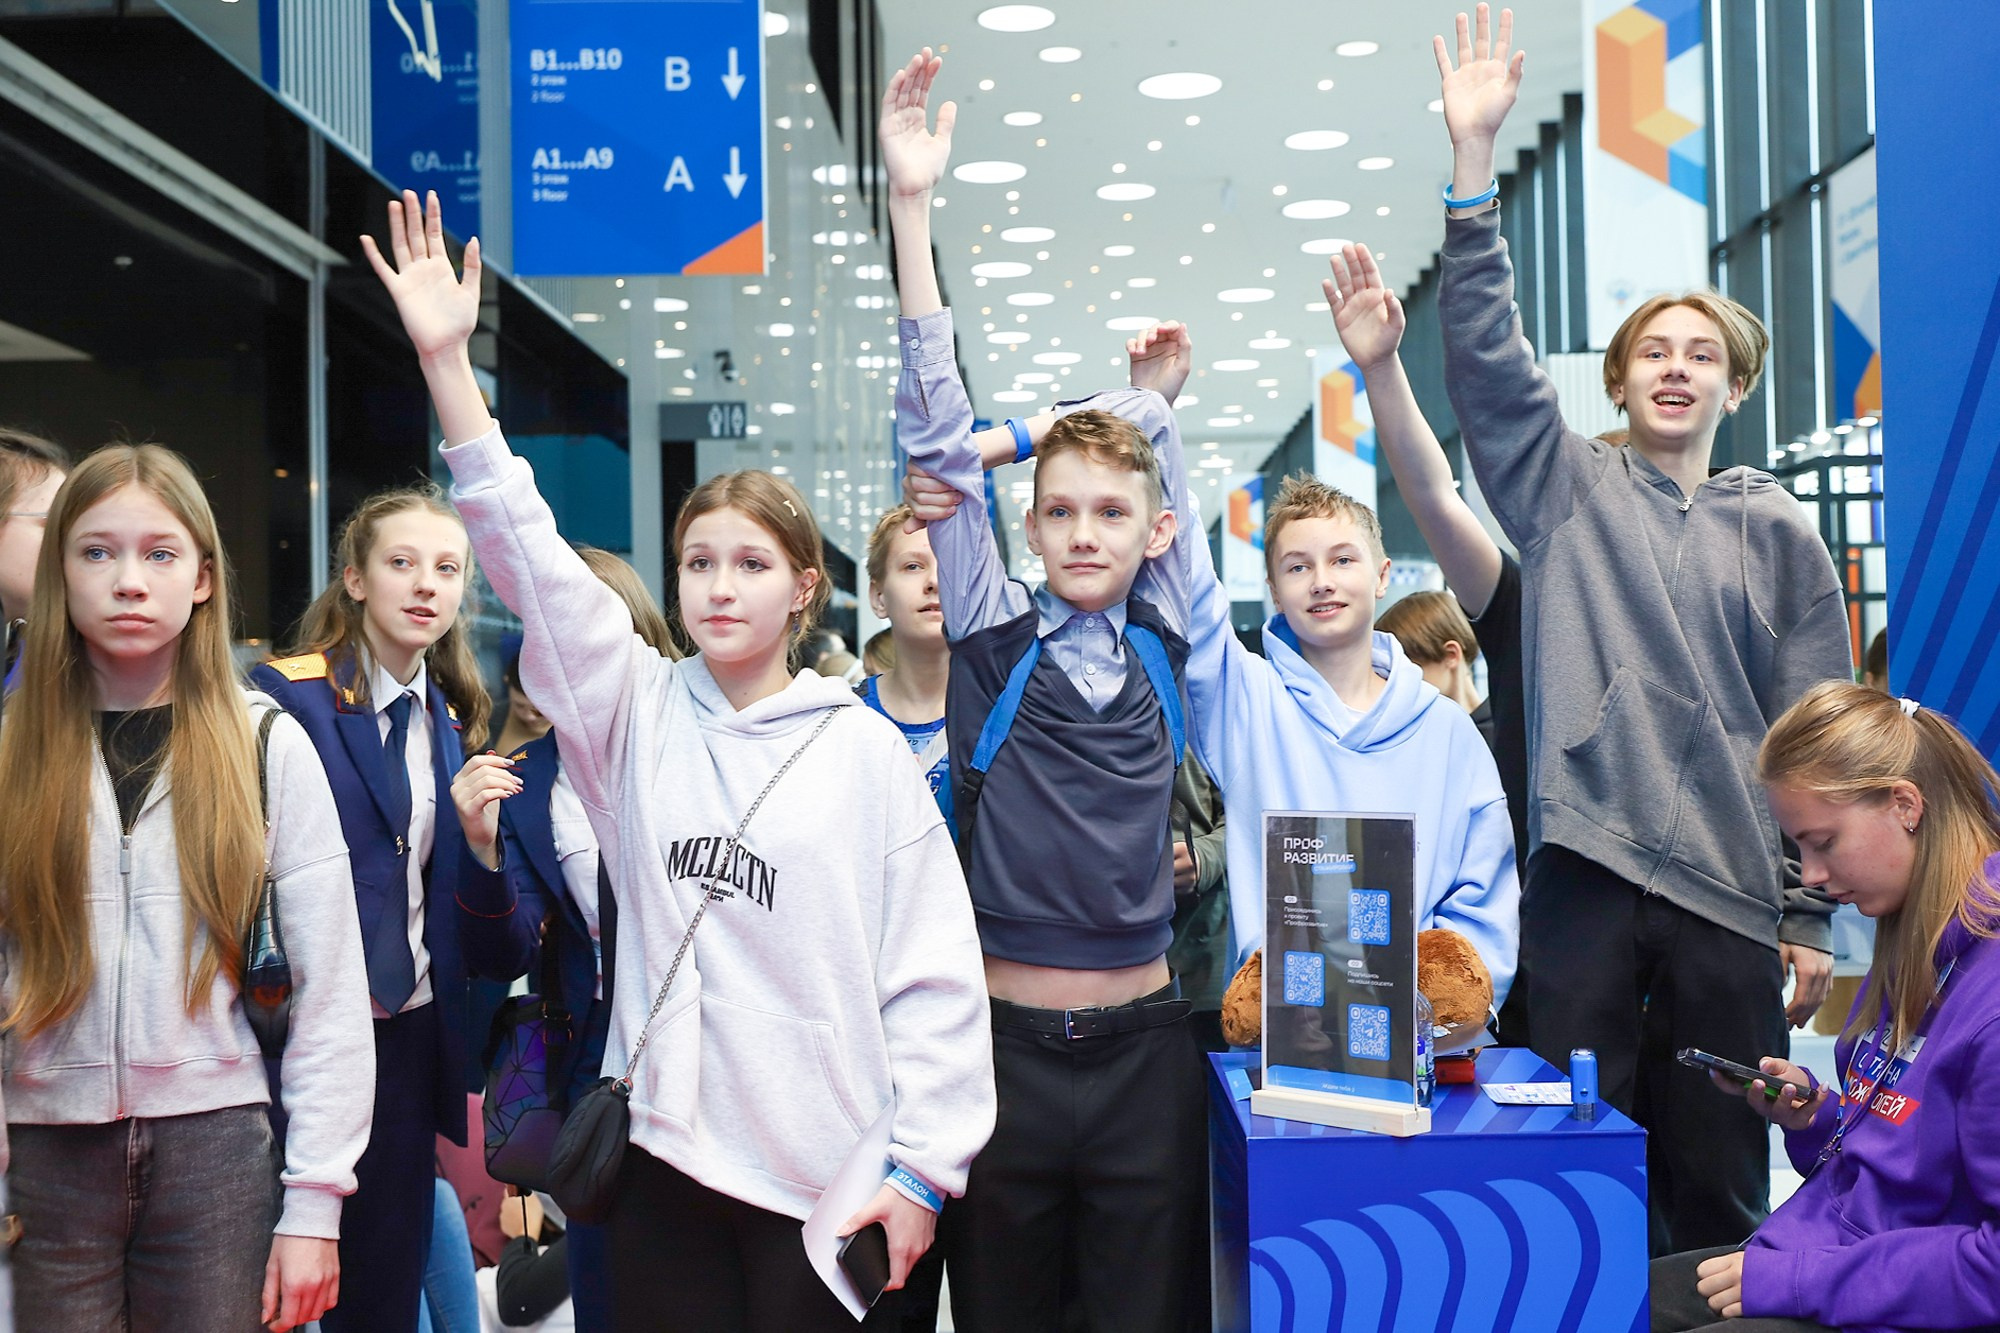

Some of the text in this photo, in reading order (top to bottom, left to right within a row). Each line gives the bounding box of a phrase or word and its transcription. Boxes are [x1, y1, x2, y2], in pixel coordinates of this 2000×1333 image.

[530, 48, 623, 71] B1...B10
[664, 56, 691, 91] B
[531, 147, 614, 170] A1...A9
[663, 155, 695, 192] A
[1283, 837, 1324, 851] ПРОФ
[1283, 852, 1355, 865] РАЗВИТИЕ
[897, 1172, 929, 1198] ЭТАЛОН
